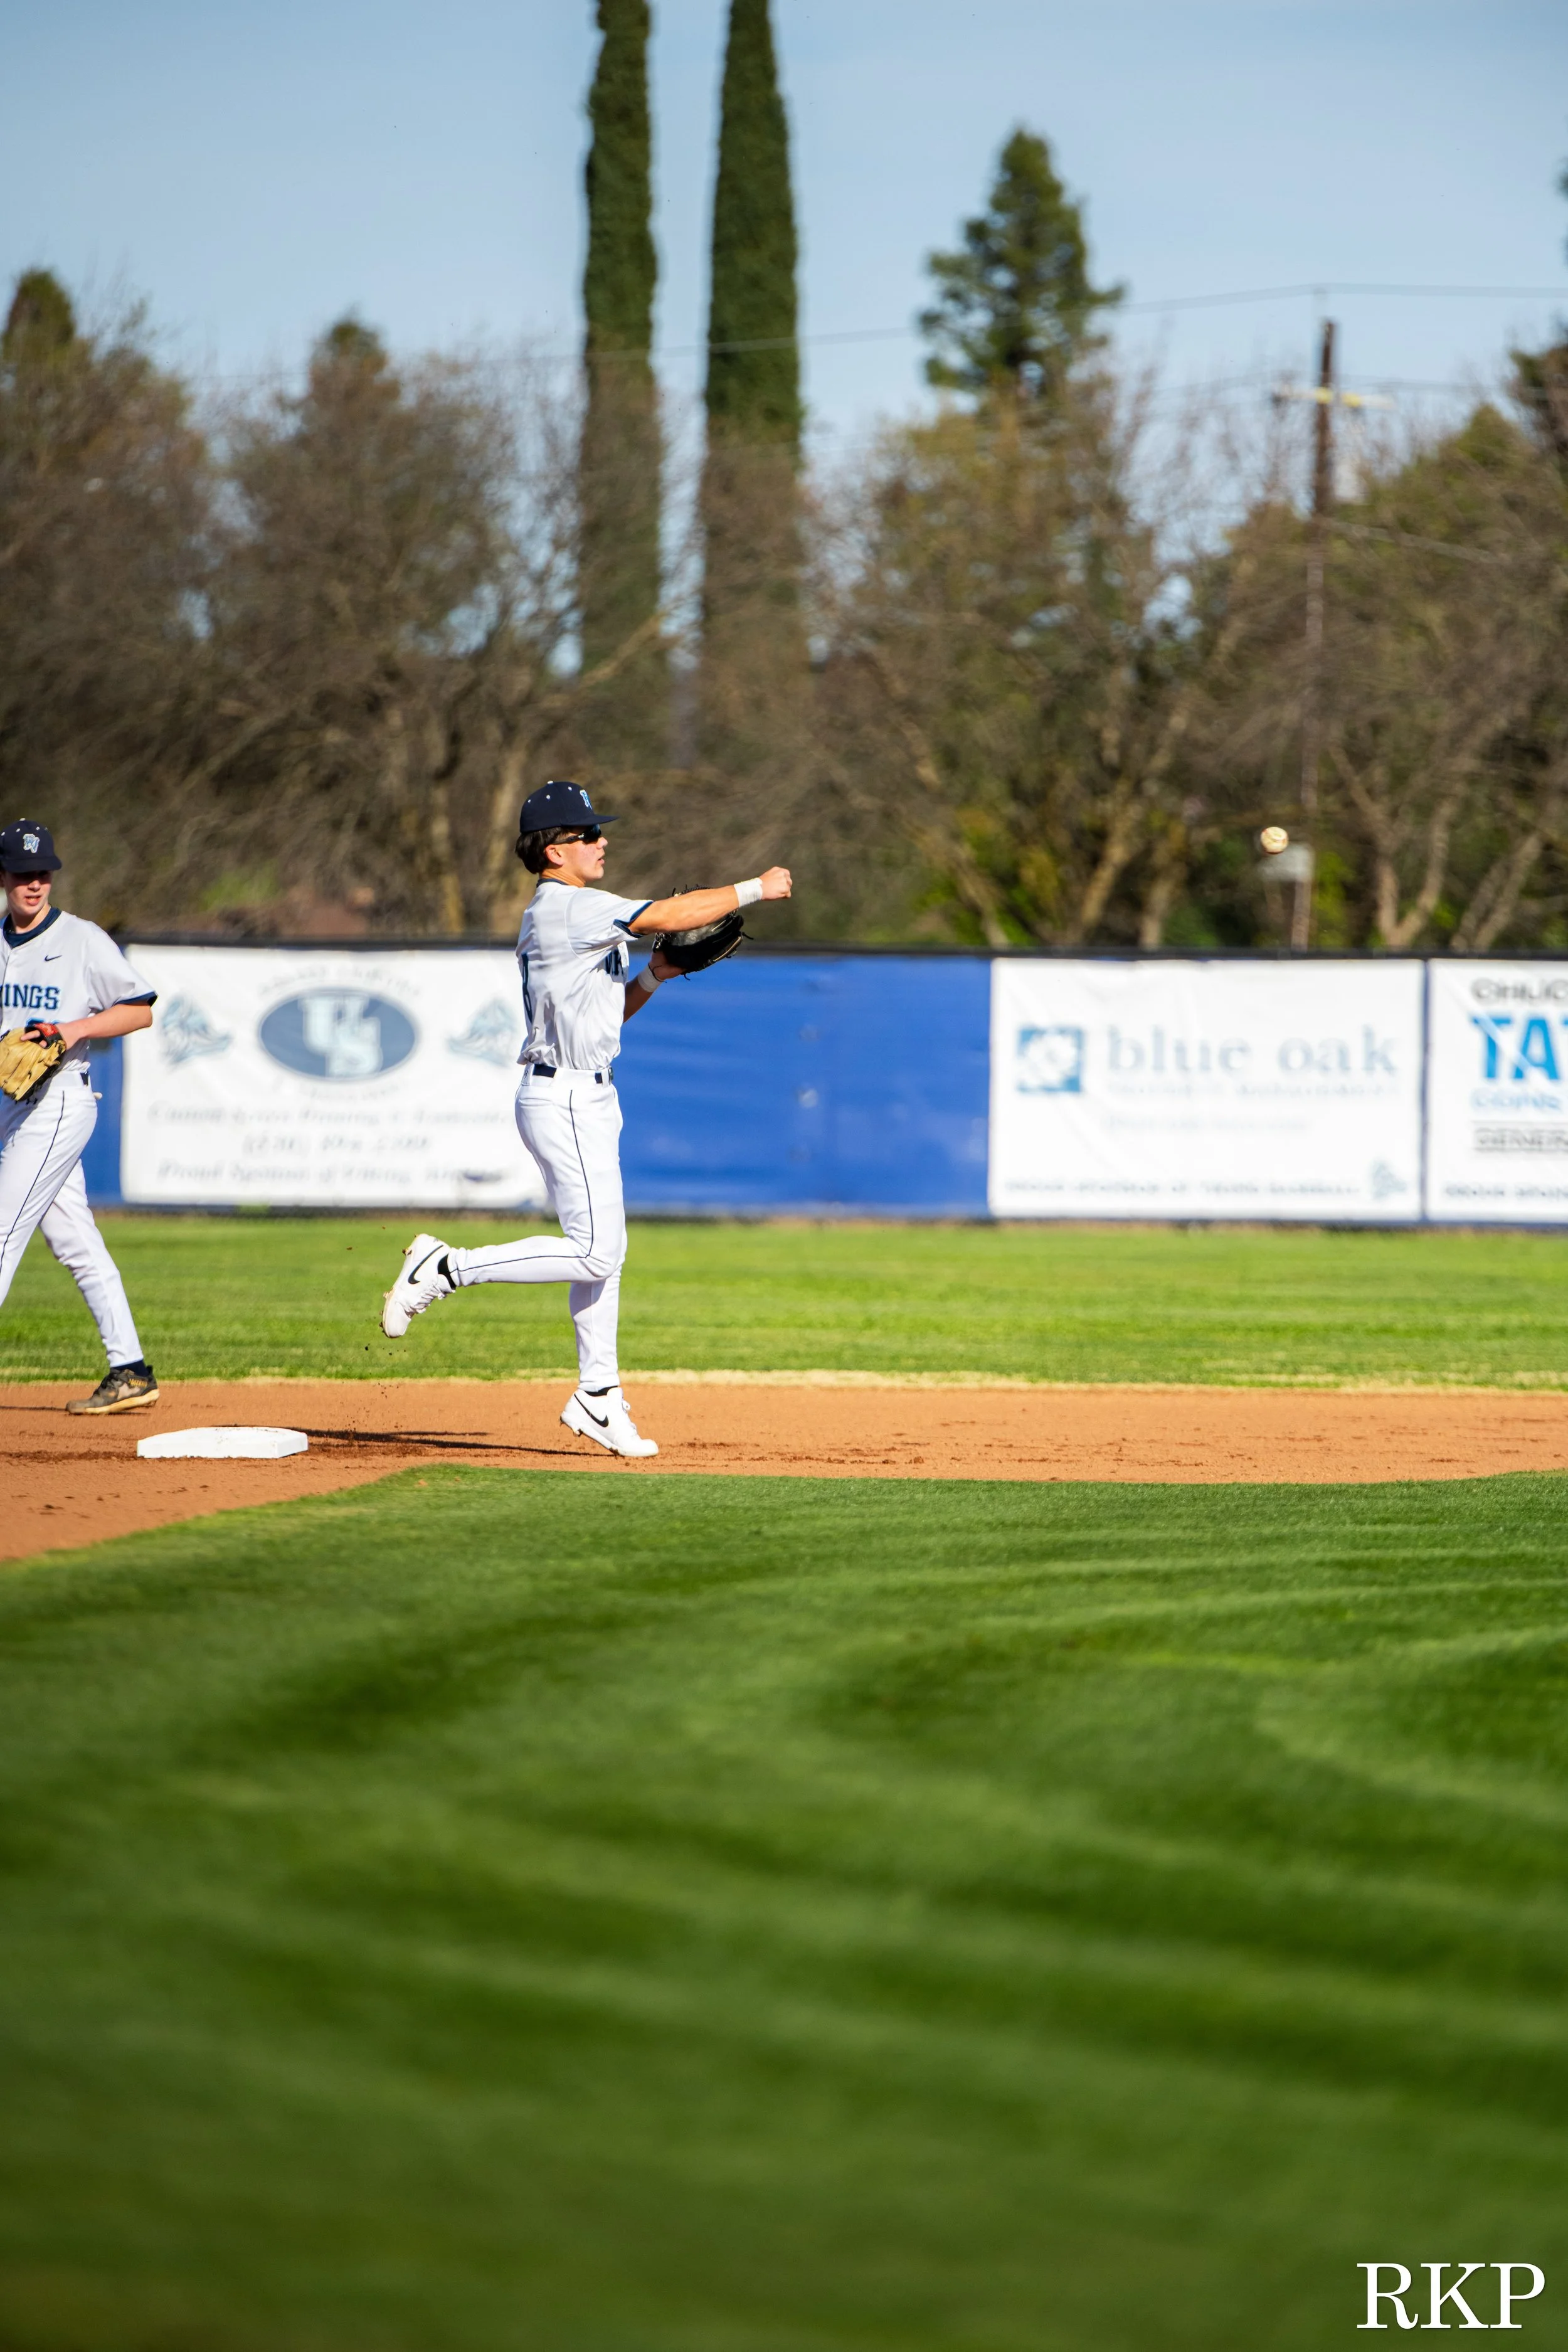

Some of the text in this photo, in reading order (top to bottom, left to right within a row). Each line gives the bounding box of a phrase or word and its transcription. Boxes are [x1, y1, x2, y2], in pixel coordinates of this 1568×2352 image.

[0, 983, 60, 1010] INGS
[1106, 1024, 1401, 1076] blue oak
[1469, 1014, 1568, 1081] TA
